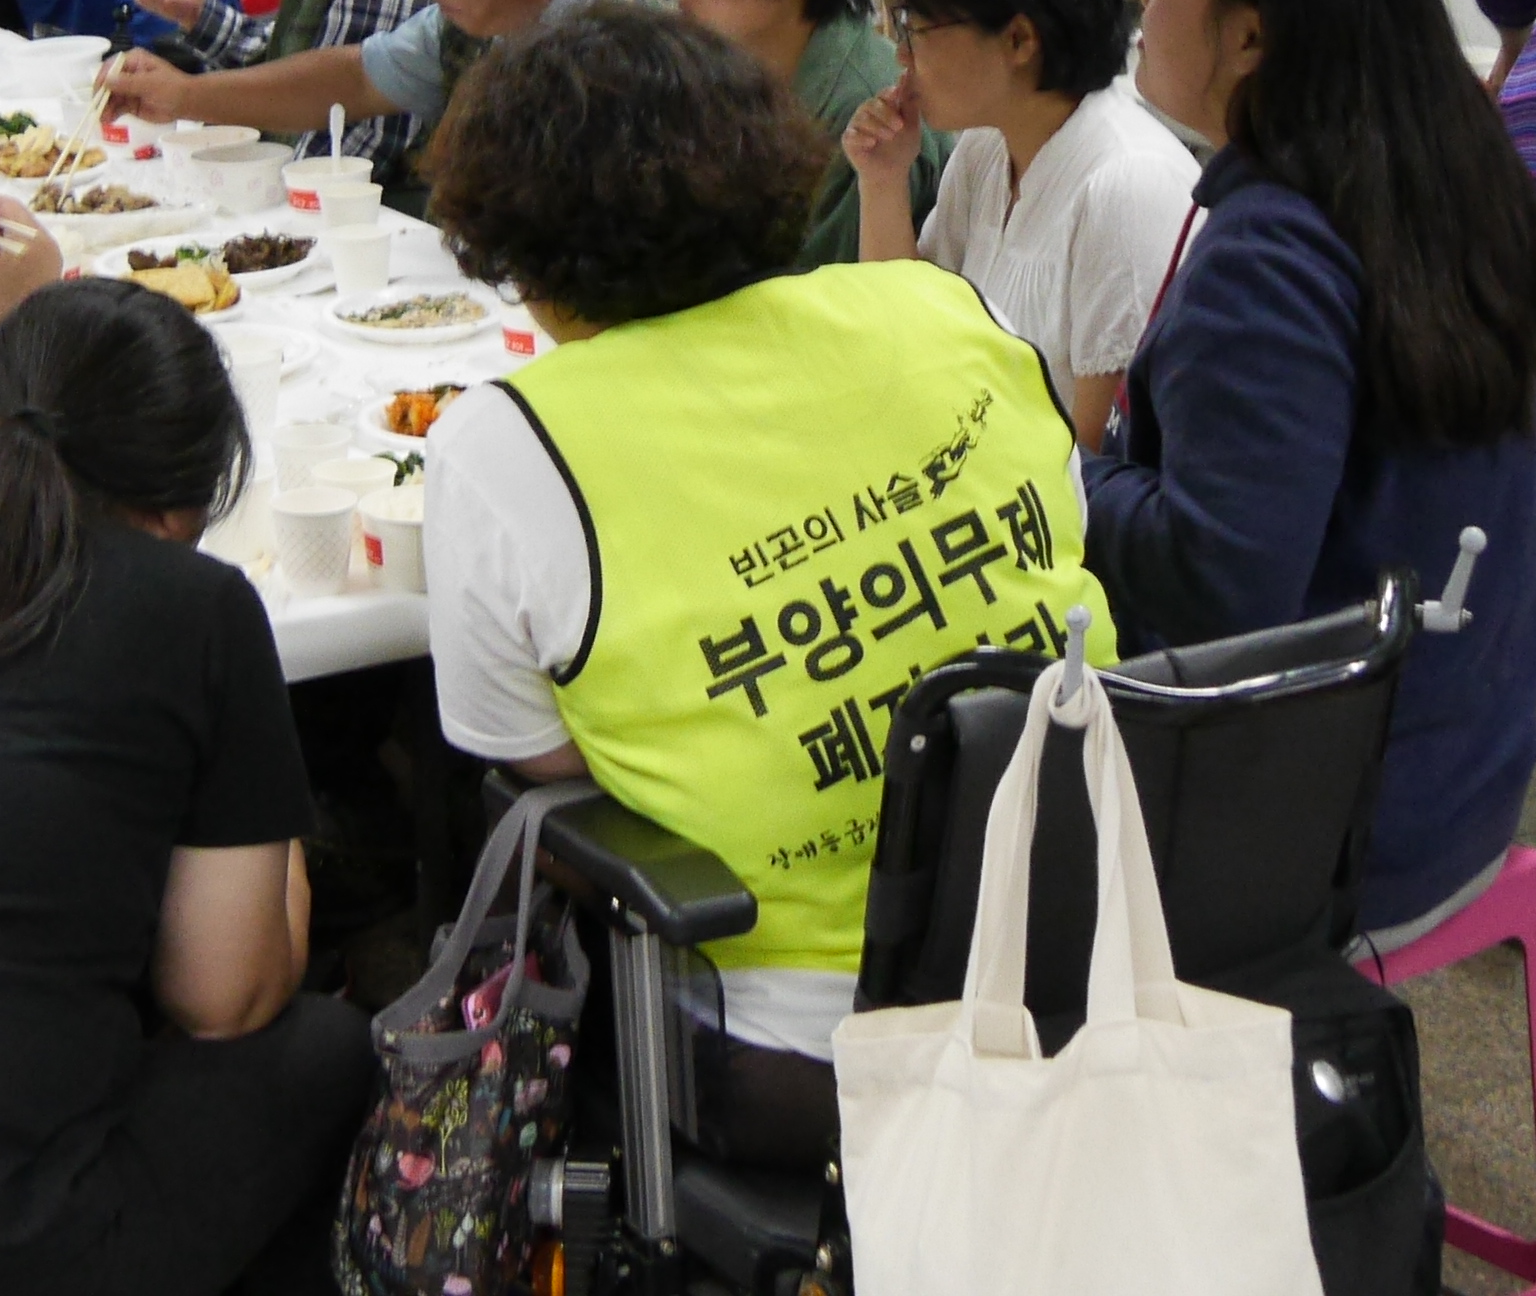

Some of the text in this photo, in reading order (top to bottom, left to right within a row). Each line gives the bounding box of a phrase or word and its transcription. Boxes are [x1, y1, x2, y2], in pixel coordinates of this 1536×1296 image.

[695, 477, 1056, 720] 부양의무제
[727, 469, 928, 589] 빈곤의 사슬
